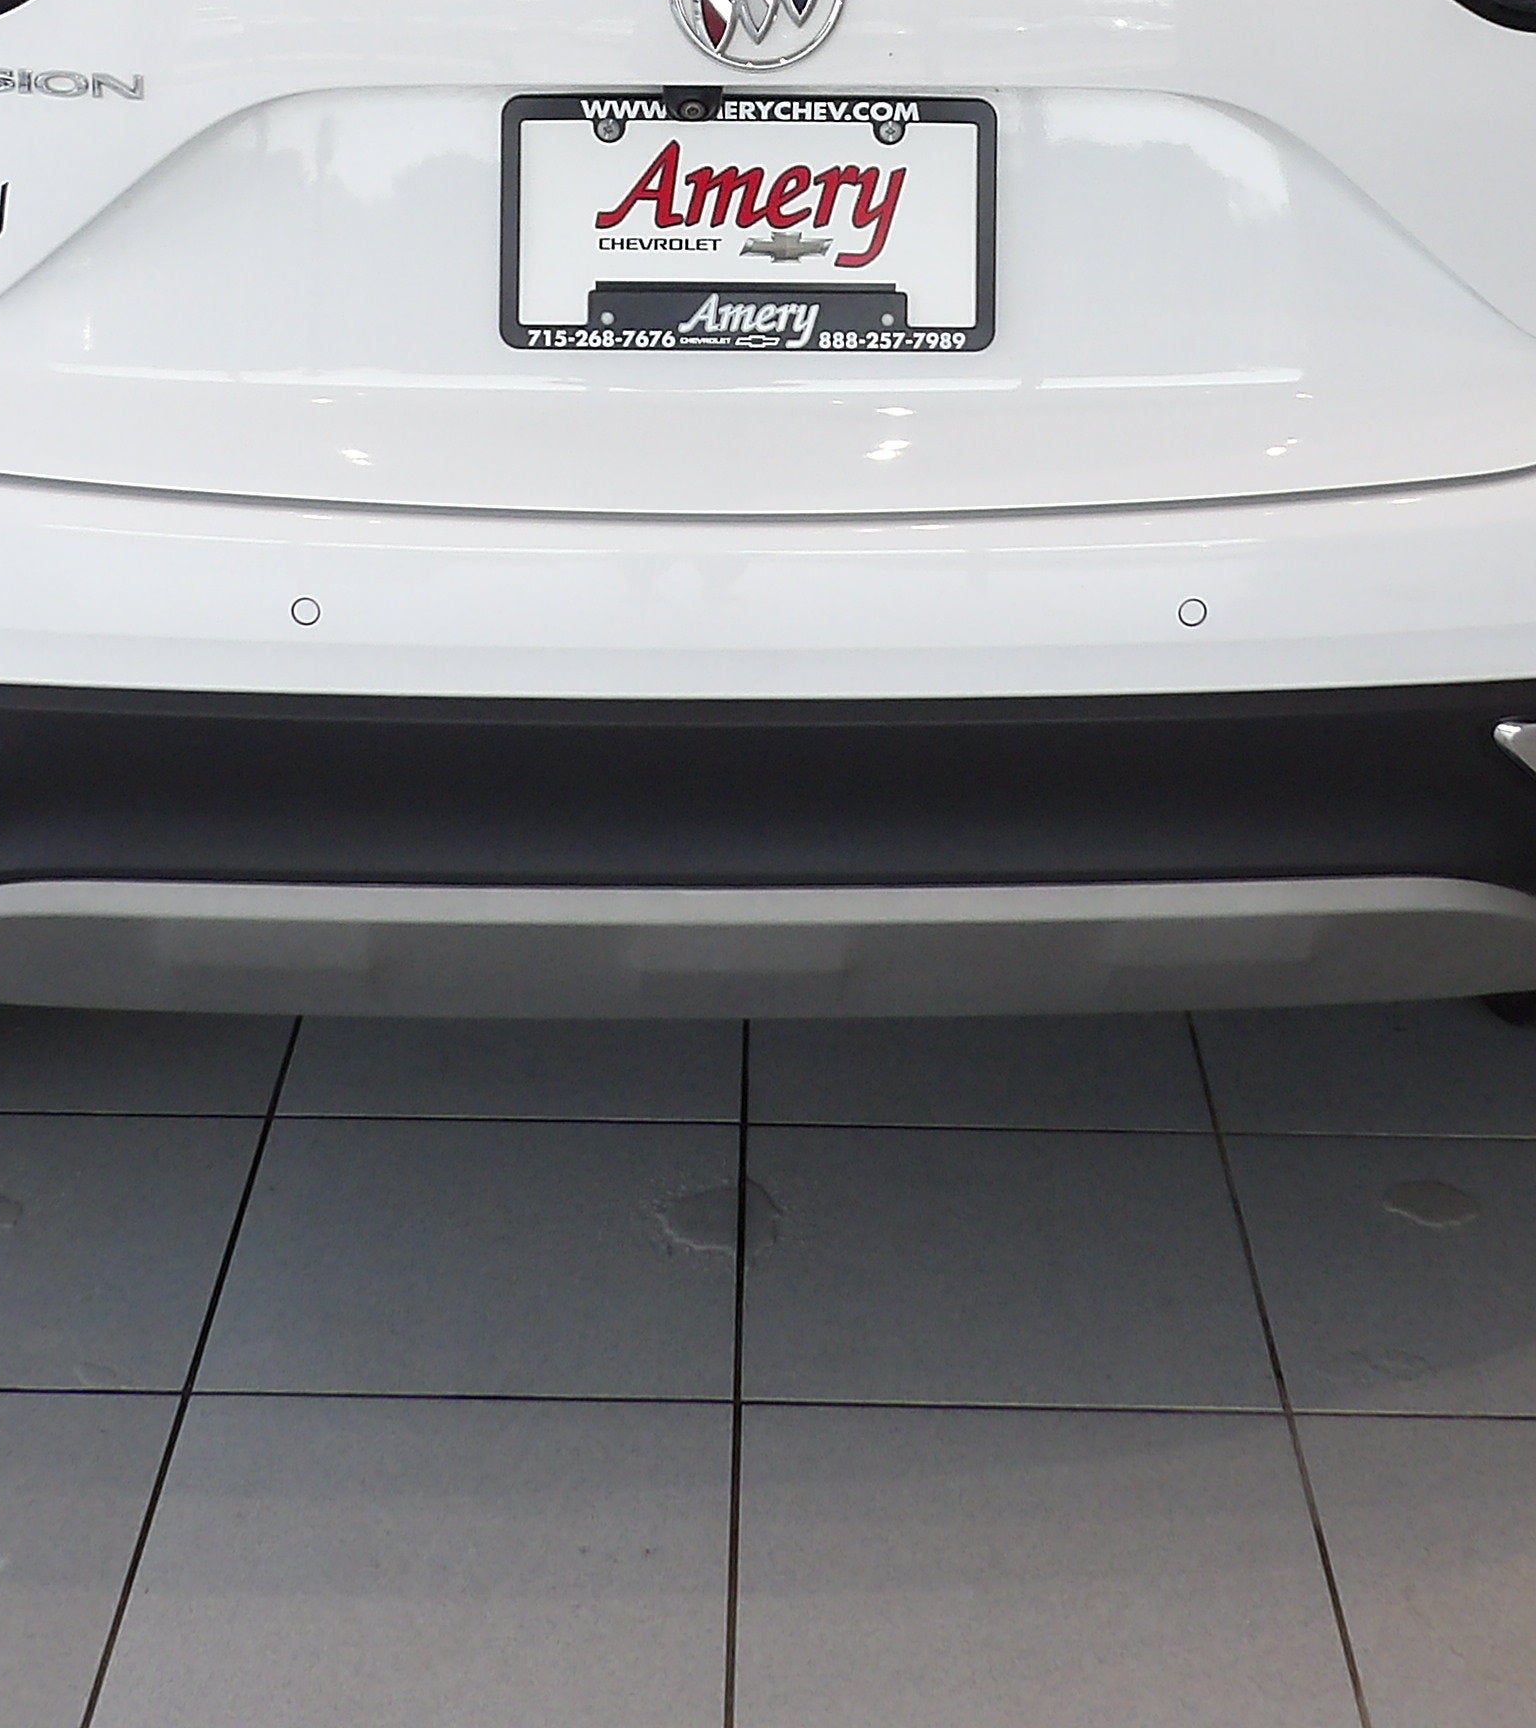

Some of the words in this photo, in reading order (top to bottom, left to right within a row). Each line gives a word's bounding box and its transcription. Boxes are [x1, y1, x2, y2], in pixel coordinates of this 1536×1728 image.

[580, 98, 920, 122] WWWERYCHEV.COM
[595, 139, 907, 268] Amery
[598, 237, 723, 252] CHEVROLET
[677, 292, 821, 349] Amery
[527, 329, 677, 349] 715-268-7676
[679, 336, 731, 345] CHEVROLET
[818, 331, 967, 351] 888-257-7989
